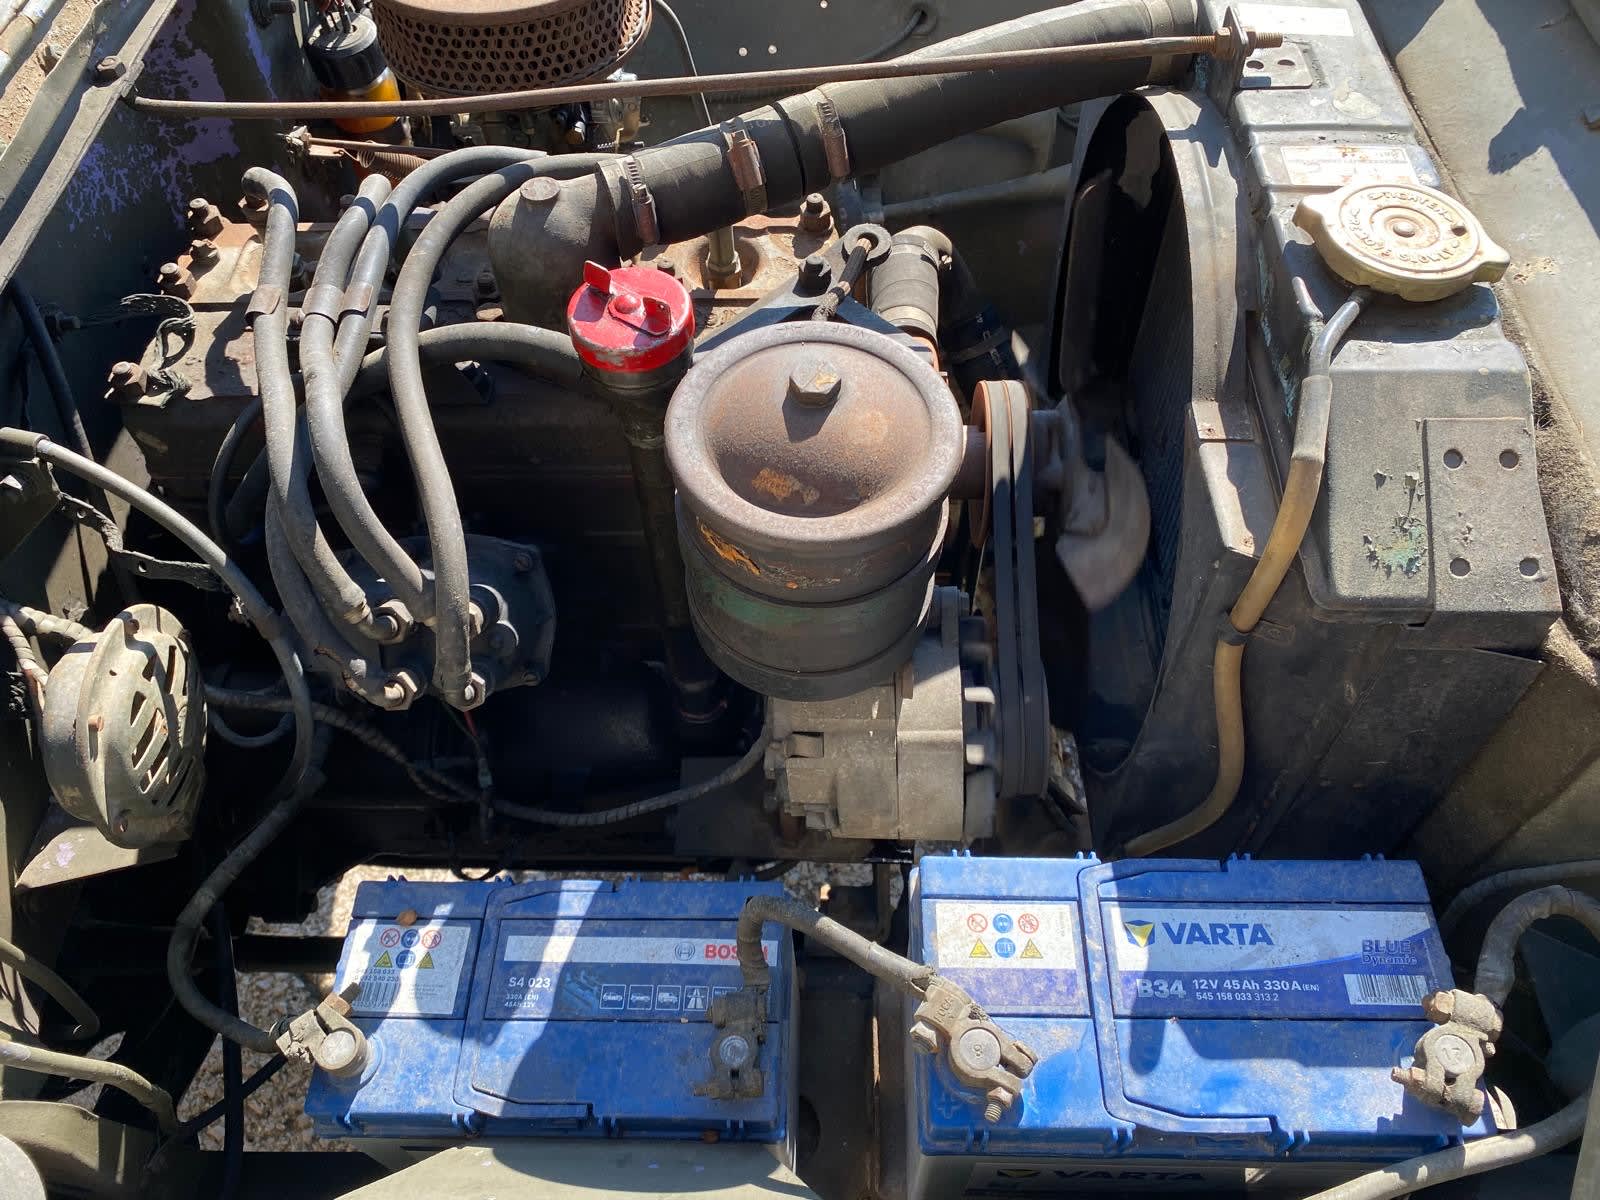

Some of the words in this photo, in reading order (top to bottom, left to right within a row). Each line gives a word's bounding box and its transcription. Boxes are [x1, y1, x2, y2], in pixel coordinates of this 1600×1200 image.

[1162, 923, 1274, 945] VARTA
[1362, 938, 1412, 953] BLUE
[1361, 953, 1418, 966] Dynamic
[508, 976, 525, 987] S4
[528, 977, 551, 988] 023
[1135, 979, 1186, 998] B34
[1193, 979, 1219, 989] 12V
[1196, 992, 1214, 1001] 545
[1217, 992, 1233, 1001] 158
[1235, 992, 1252, 1001] 033
[1055, 1169, 1204, 1182] VARTA
